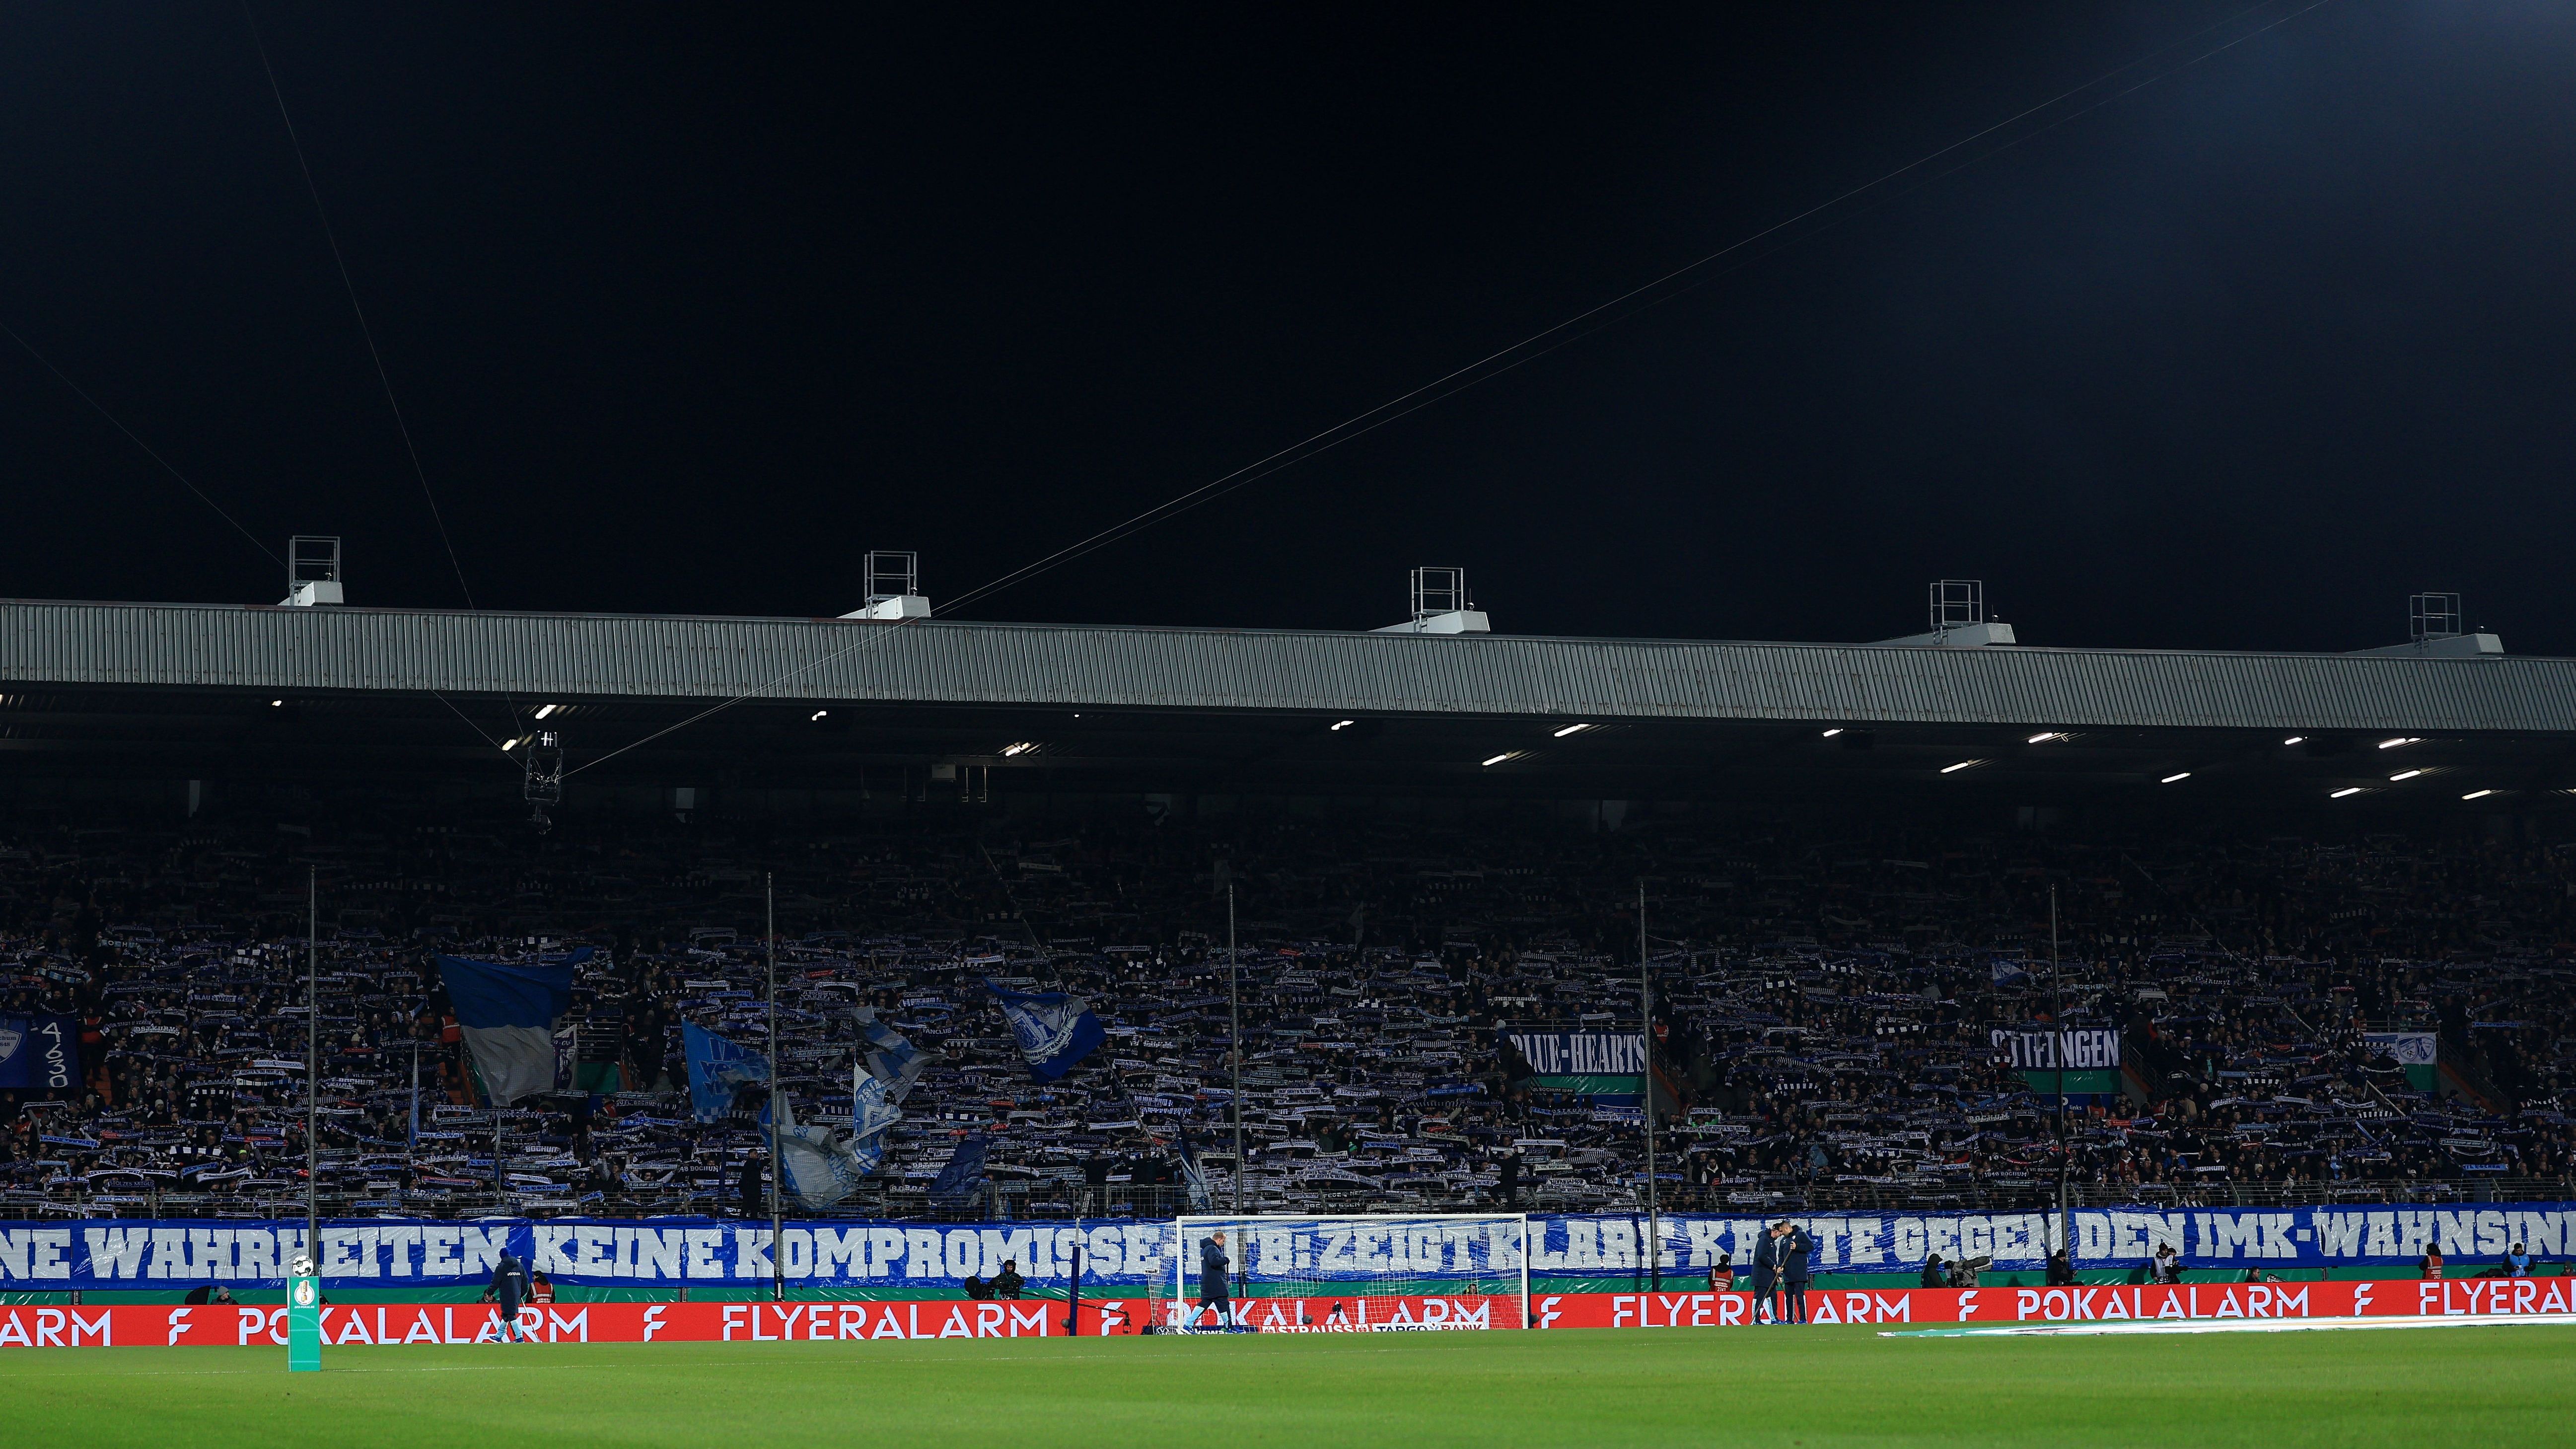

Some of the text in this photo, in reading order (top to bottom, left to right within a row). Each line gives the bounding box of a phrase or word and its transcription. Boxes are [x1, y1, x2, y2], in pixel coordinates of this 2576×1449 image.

[84, 1226, 508, 1279] WAHRHEITEN
[532, 1226, 723, 1279] KEINE
[1686, 1218, 1884, 1267] KATE
[1895, 1217, 2062, 1263] GEGEN
[2075, 1213, 2185, 1260] DEN
[723, 1303, 1048, 1342] FLYERALARM
[2017, 1285, 2308, 1321] POKALALARM
